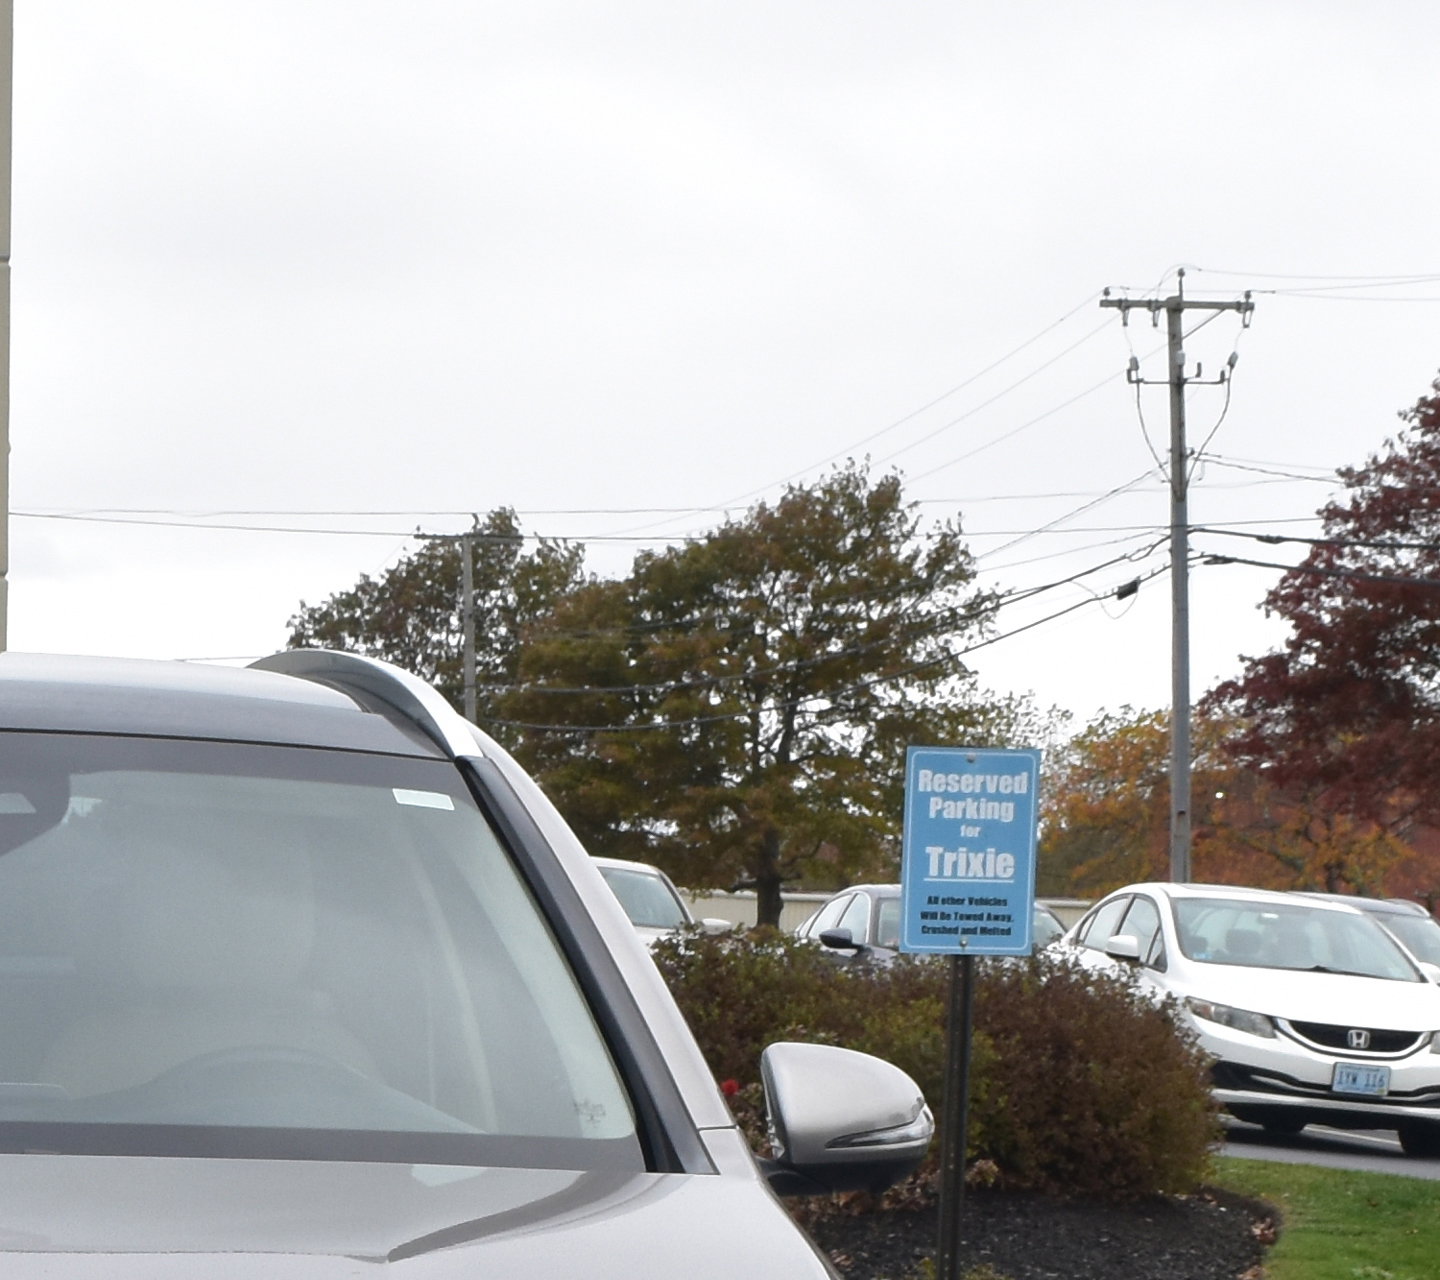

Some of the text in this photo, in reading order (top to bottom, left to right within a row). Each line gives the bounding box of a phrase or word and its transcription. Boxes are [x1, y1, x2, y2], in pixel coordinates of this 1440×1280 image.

[918, 769, 1029, 794] Reserved
[929, 797, 1015, 823] Parking
[960, 824, 982, 838] for
[925, 846, 1015, 878] Trixie
[927, 895, 939, 905] All
[941, 896, 966, 905] other
[921, 910, 938, 920] Will
[954, 911, 984, 921] Towed
[921, 925, 1012, 936] Crushed and Melted
